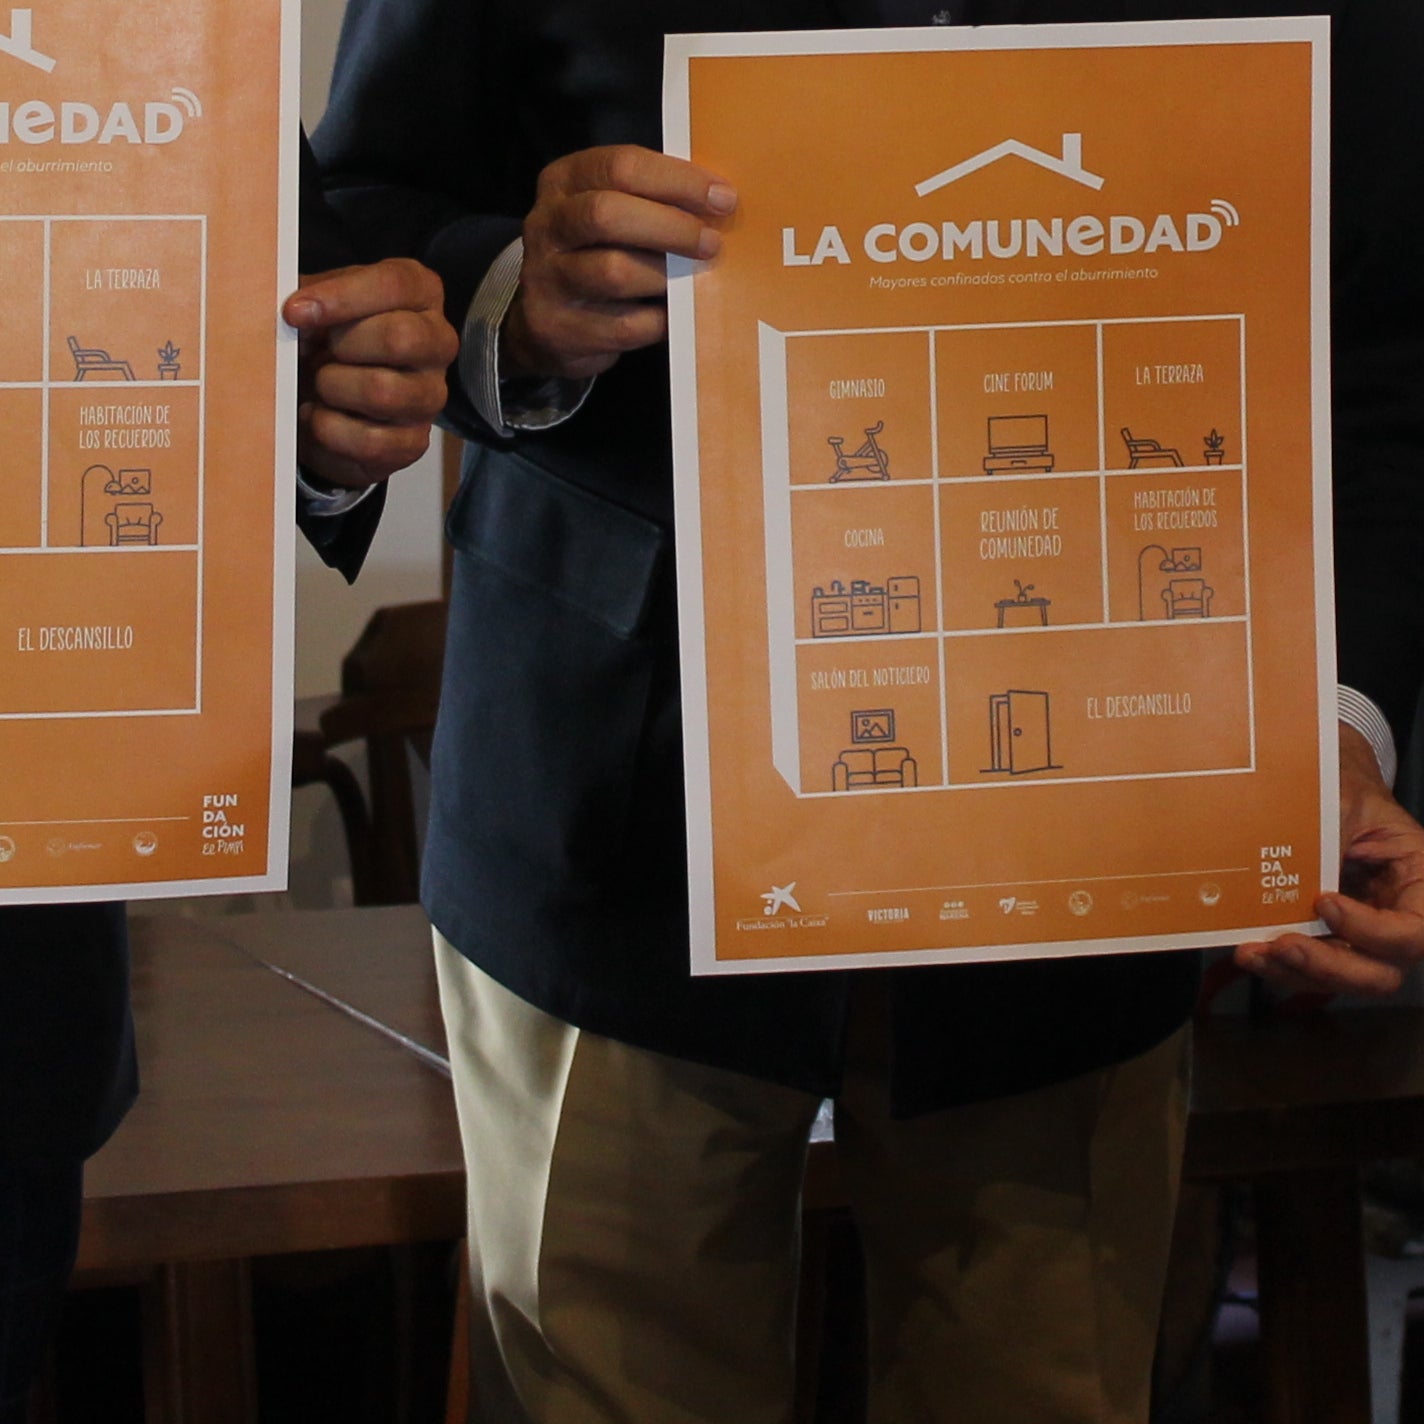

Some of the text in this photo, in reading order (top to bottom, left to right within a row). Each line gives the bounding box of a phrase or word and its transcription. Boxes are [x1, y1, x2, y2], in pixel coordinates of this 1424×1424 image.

[0, 157, 13, 173] el
[16, 159, 113, 172] aburrimiento
[783, 226, 851, 266] LA
[86, 268, 159, 289] LA TERRAZA
[870, 268, 1158, 290] Mayores confinados contra el aburrimiento
[984, 372, 1053, 392] CINE FORUM
[1136, 364, 1203, 385] LA TERRAZA
[830, 379, 885, 399] GIMNASIO
[80, 402, 170, 426] HABITACIÓN DE
[79, 428, 171, 449] LOS RECUERDOS
[1134, 486, 1216, 509] HABITACIÓN DE
[981, 508, 1058, 534] REUNIÓN DE
[1134, 510, 1218, 531] LOS RECUERDOS
[845, 528, 884, 547] COCINA
[980, 535, 1061, 560] COMUNEDAD
[19, 626, 132, 651] EL DESCANSILLO
[811, 666, 929, 689] SALÓN DEL NOTICIERO
[1087, 693, 1191, 719] EL DESCANSILLO
[204, 795, 237, 808] FUN
[203, 810, 227, 822] DA
[203, 822, 244, 838] CIÓN
[1261, 846, 1291, 858] FUN
[1261, 861, 1283, 872] DA
[1261, 871, 1299, 888] CIÓN
[737, 920, 785, 930] Fundación
[868, 908, 909, 921] VICTORIA
